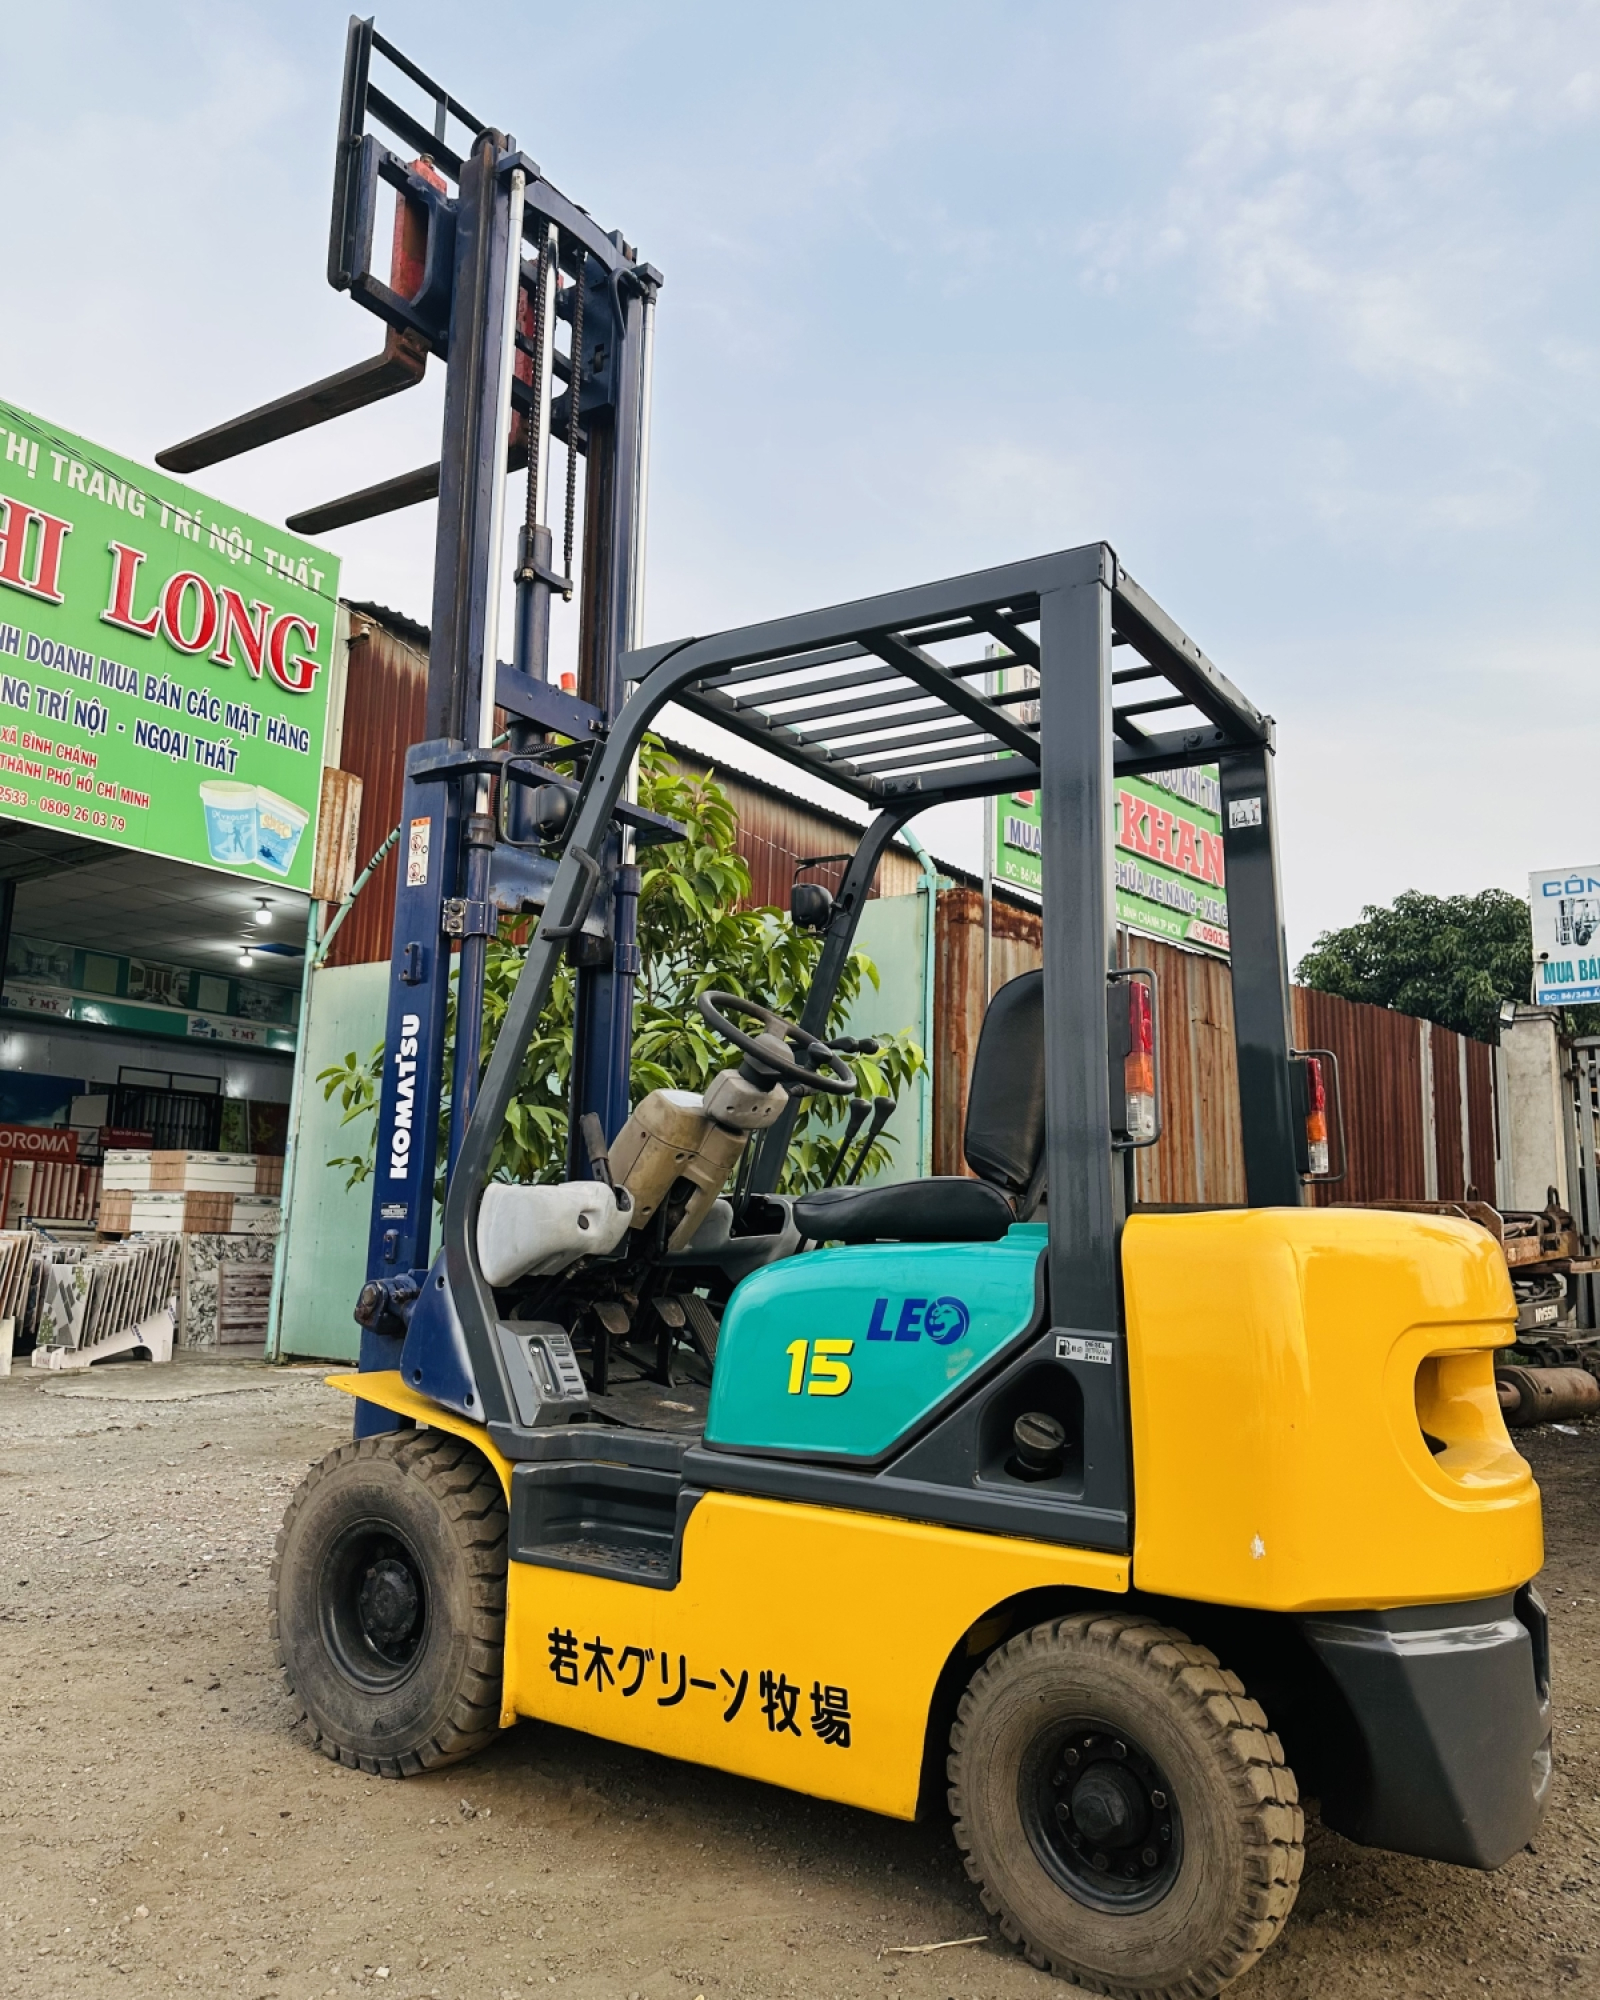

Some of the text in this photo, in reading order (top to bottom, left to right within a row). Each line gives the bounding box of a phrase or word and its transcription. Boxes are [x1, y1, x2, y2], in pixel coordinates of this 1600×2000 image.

[50, 450, 147, 519] TRANG
[159, 499, 204, 544] TRÍ
[209, 522, 254, 566] NỘI
[263, 545, 326, 596] THẤT
[100, 538, 323, 694] LONG
[25, 632, 94, 682] DOANH
[98, 657, 140, 697] MUA
[144, 673, 183, 711] BÁN
[186, 687, 222, 724] CÁC
[224, 702, 261, 740] MẶT
[266, 714, 310, 754] HÀNG
[35, 686, 73, 722] TRÍ
[73, 696, 109, 738] NỘI
[134, 717, 189, 763] NGOẠI
[194, 737, 239, 775] THẤT
[0, 753, 42, 780] THÀNH
[46, 767, 74, 788] PHỐ
[97, 781, 117, 801] CHÍ
[120, 787, 150, 809] MINH
[22, 730, 53, 756] BÌNH
[56, 744, 98, 769] CHÁNH
[39, 796, 70, 817] 0809
[74, 807, 90, 823] 26
[92, 811, 108, 828] 03
[110, 815, 125, 832] 79
[1009, 816, 1041, 852] MUA
[1148, 874, 1163, 901] XE
[1205, 897, 1219, 922] XE
[1543, 960, 1575, 984] MUA
[389, 1014, 421, 1180] KOMATSU
[786, 1339, 854, 1397] 15
